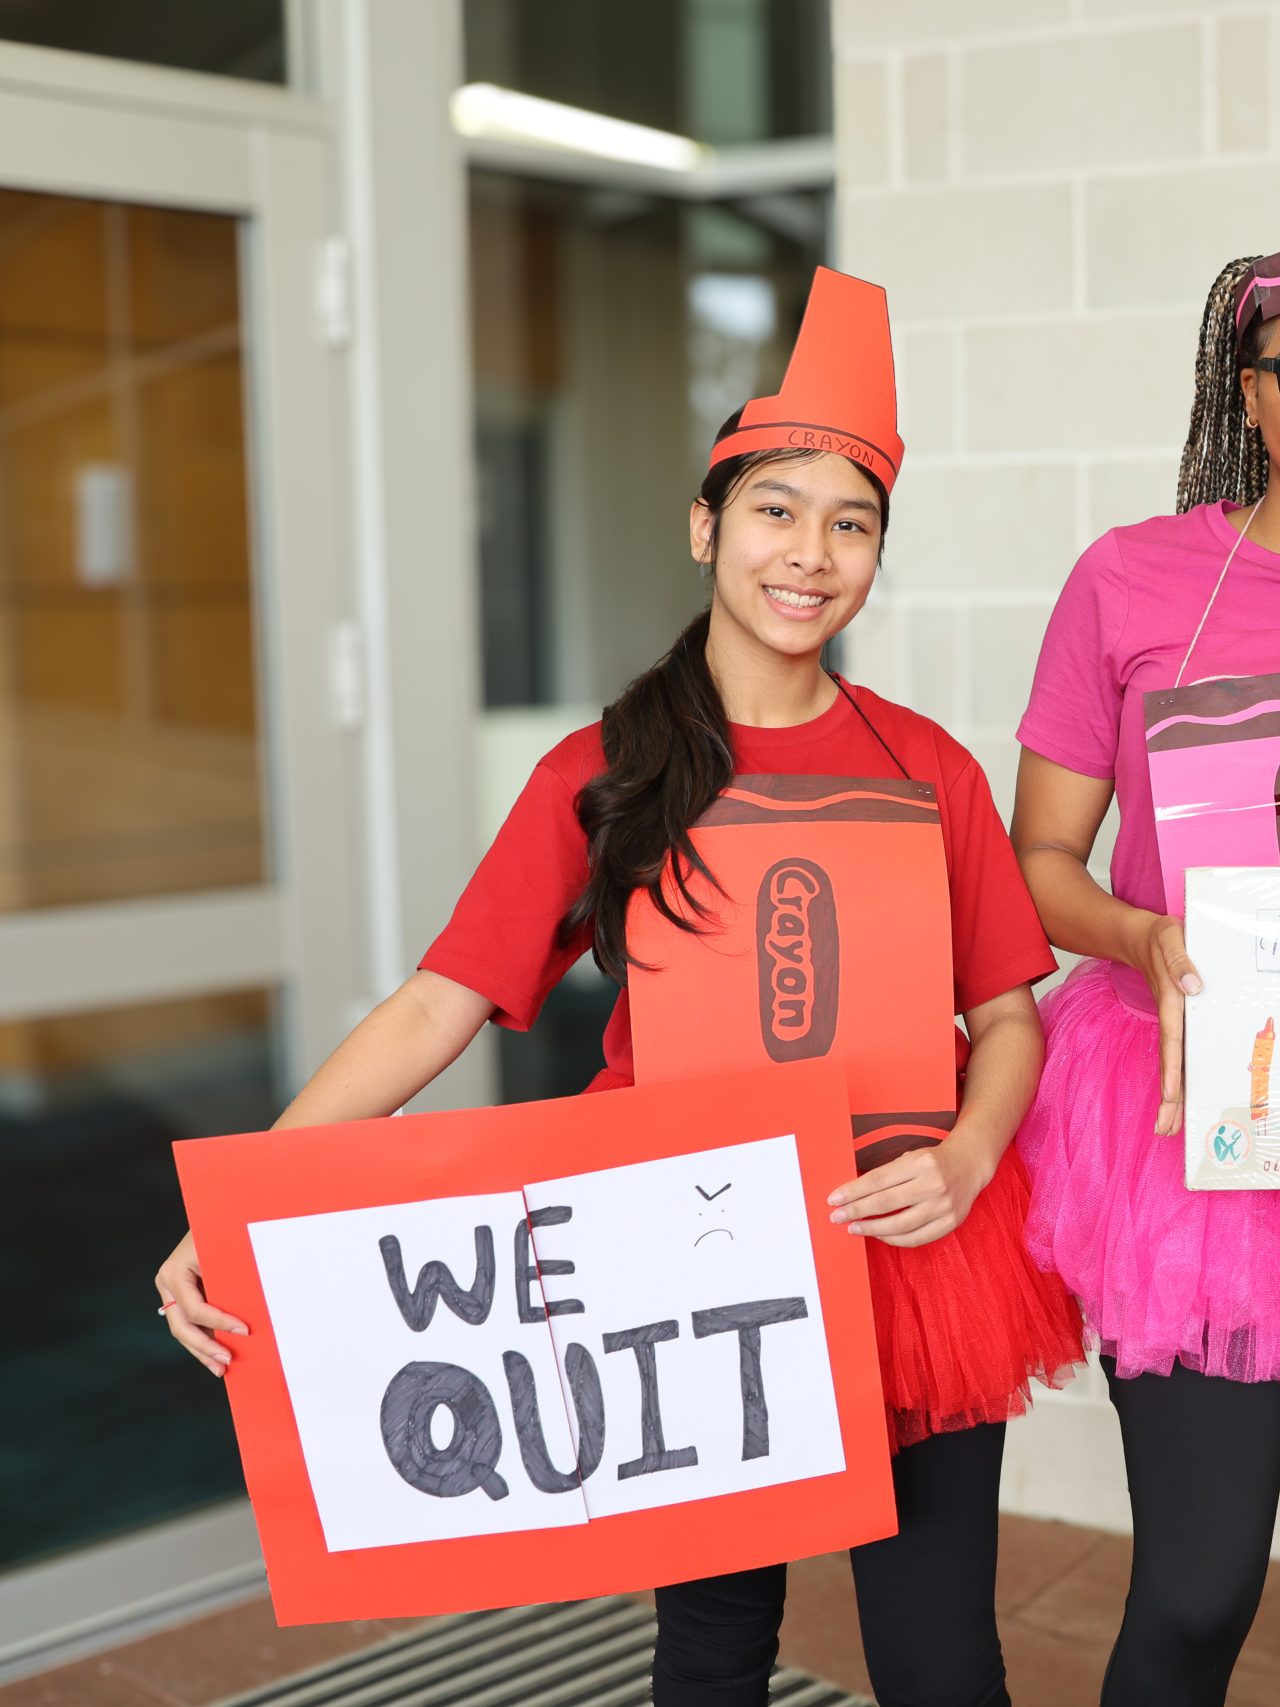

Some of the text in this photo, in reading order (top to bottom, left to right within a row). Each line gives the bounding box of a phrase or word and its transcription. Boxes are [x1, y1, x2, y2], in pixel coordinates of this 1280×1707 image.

[787, 429, 875, 467] CRAYON
[767, 867, 816, 1030] Crayon
[378, 1205, 585, 1332] WE
[379, 1296, 809, 1501] QUIT
